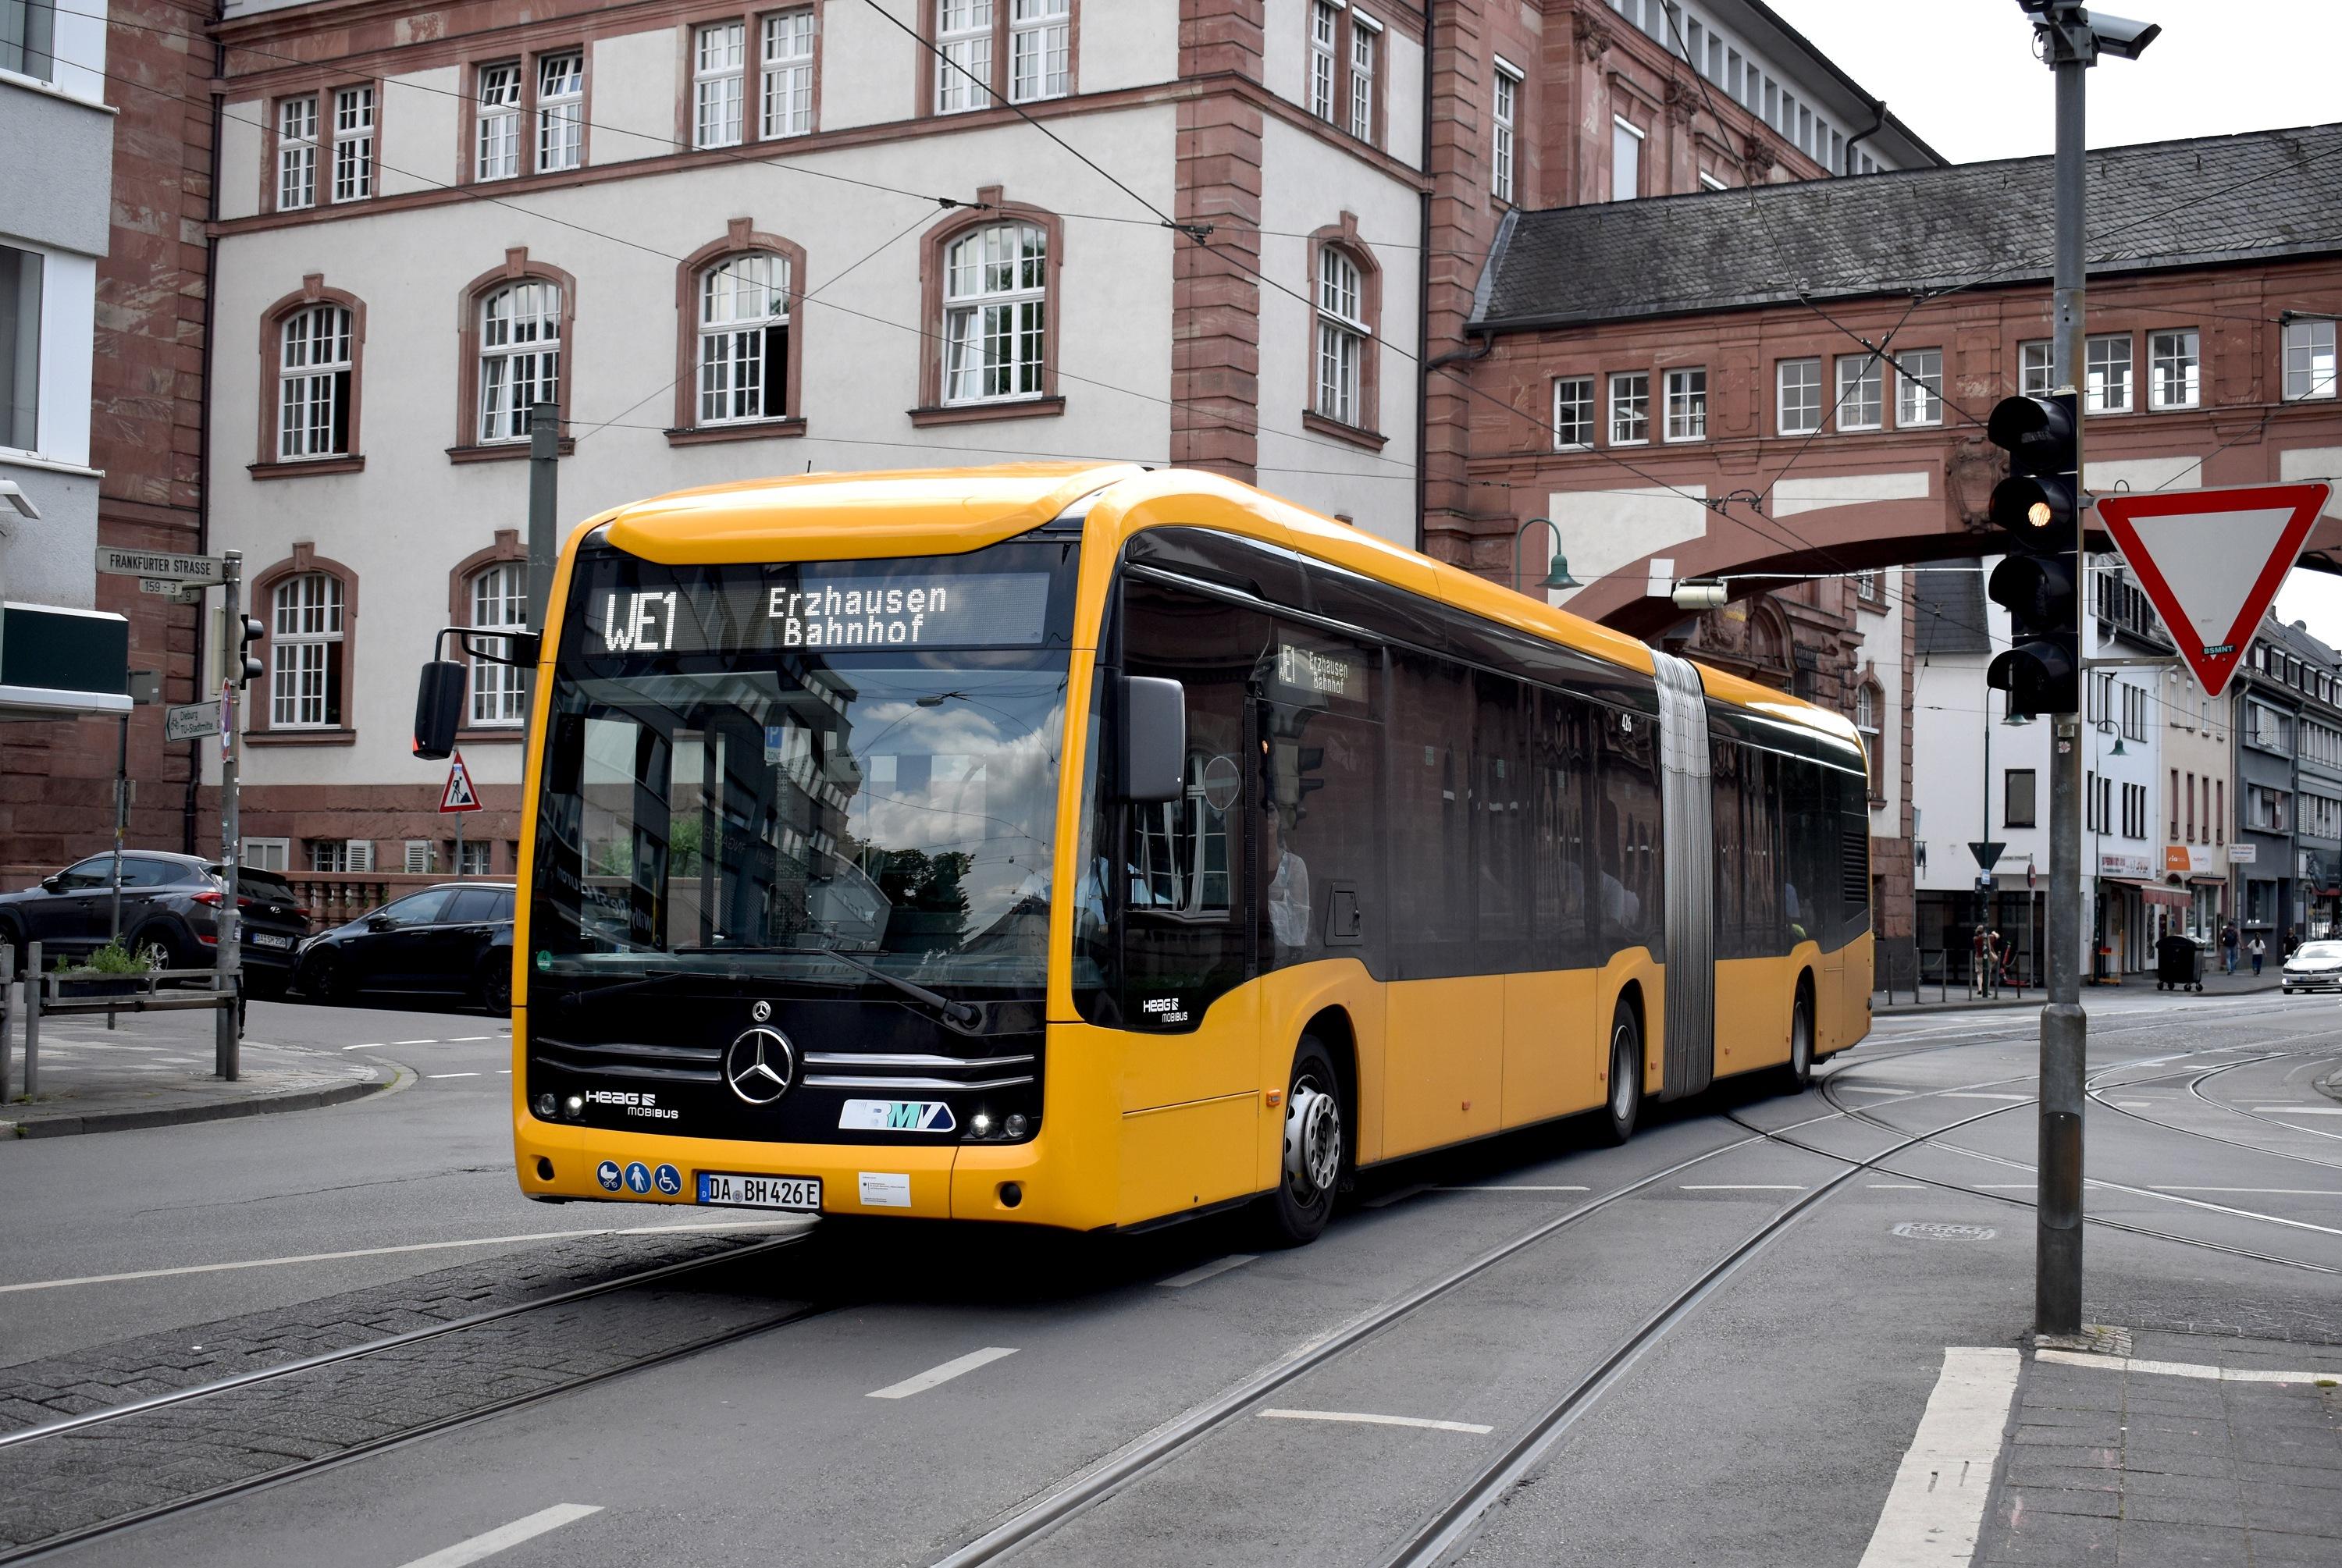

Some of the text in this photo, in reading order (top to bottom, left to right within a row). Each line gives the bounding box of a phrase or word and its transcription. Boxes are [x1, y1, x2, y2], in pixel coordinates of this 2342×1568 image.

[110, 554, 211, 575] FRANKFURTER STRASSE
[145, 581, 160, 592] 159
[171, 583, 176, 593] 3
[186, 591, 190, 601] 9
[768, 585, 947, 617] Erzhausen
[604, 591, 677, 651] WE1
[784, 613, 924, 646] Bahnhof
[2204, 645, 2233, 655] BSMNT
[1309, 651, 1348, 678] Erzhausen
[1313, 671, 1344, 694] Bahnhof
[180, 710, 198, 721] Dieburg
[1621, 713, 1632, 732] 426
[180, 721, 213, 734] TU-Stadtmitte
[1162, 1012, 1188, 1023] MOBIBUS
[628, 1107, 678, 1119] MOBIBUS
[865, 1102, 944, 1129] RMV
[710, 1178, 731, 1200] DA
[745, 1179, 767, 1203] BH
